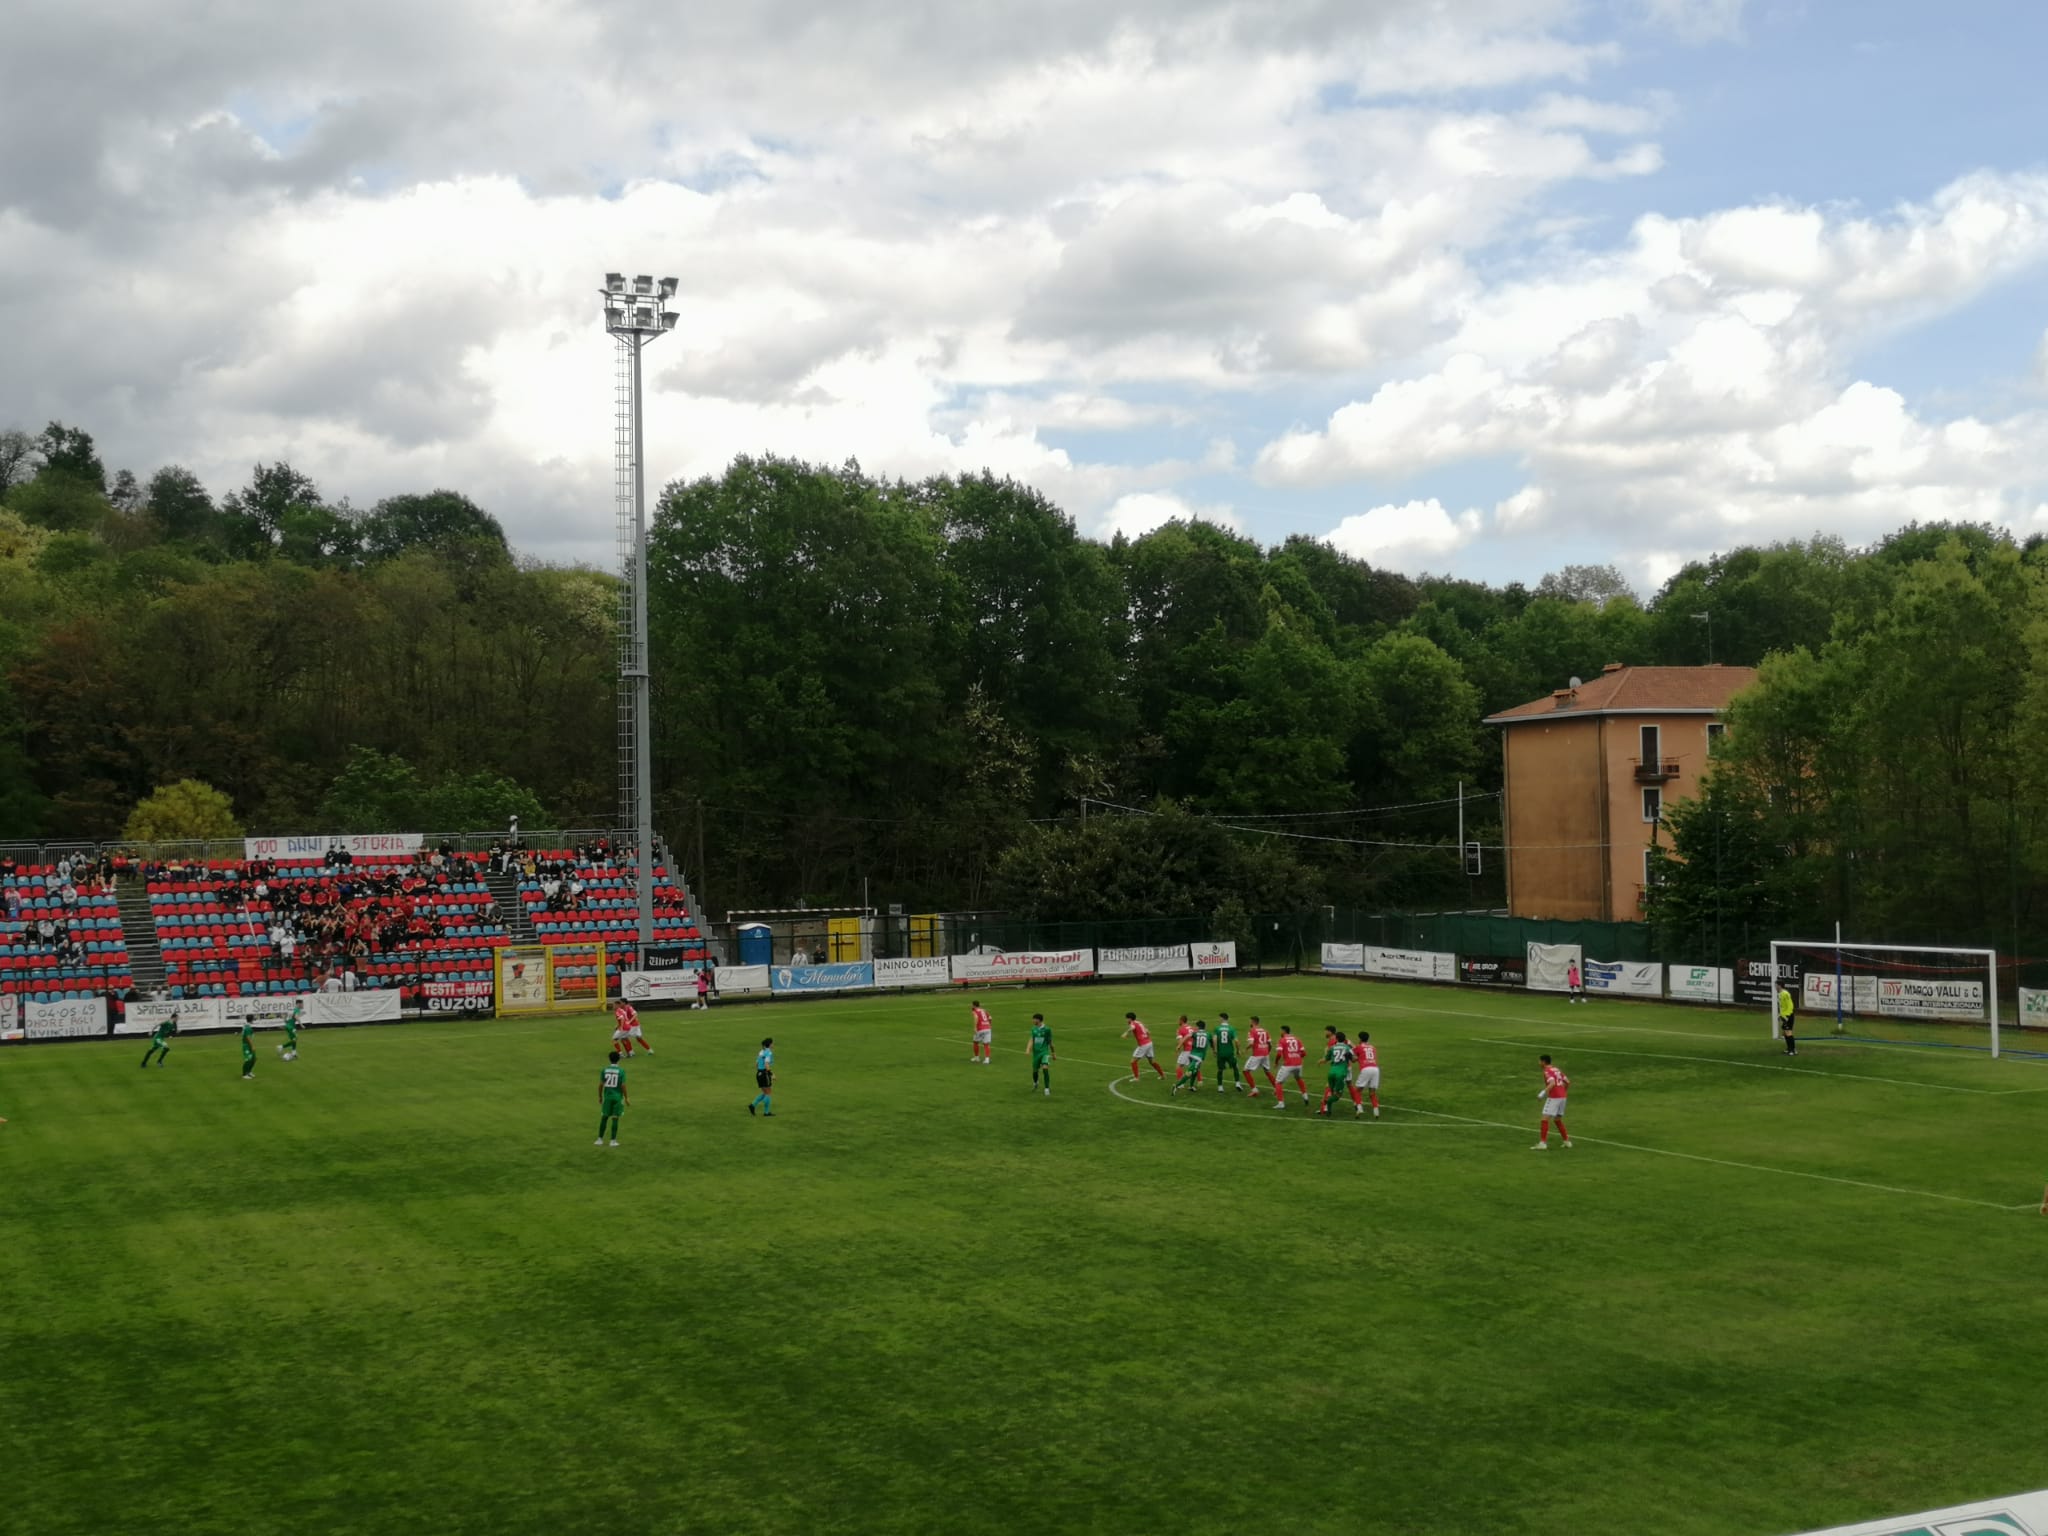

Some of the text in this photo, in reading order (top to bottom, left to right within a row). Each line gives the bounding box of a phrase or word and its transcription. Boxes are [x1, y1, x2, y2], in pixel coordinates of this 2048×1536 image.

[254, 838, 277, 853] 100
[288, 838, 322, 853] ANNI
[649, 956, 679, 967] Ultras
[910, 958, 946, 969] GOMME
[991, 952, 1081, 966] Antonioli
[423, 982, 455, 997] TESTI
[1904, 984, 1933, 997] MARCO
[1936, 986, 1960, 998] VALLI
[227, 999, 249, 1013] Bar
[1880, 998, 1920, 1007] TRASPORTI
[1196, 1035, 1207, 1048] 10
[1220, 1031, 1229, 1043] 8
[1286, 1039, 1298, 1052] 33
[604, 1073, 618, 1087] 20
